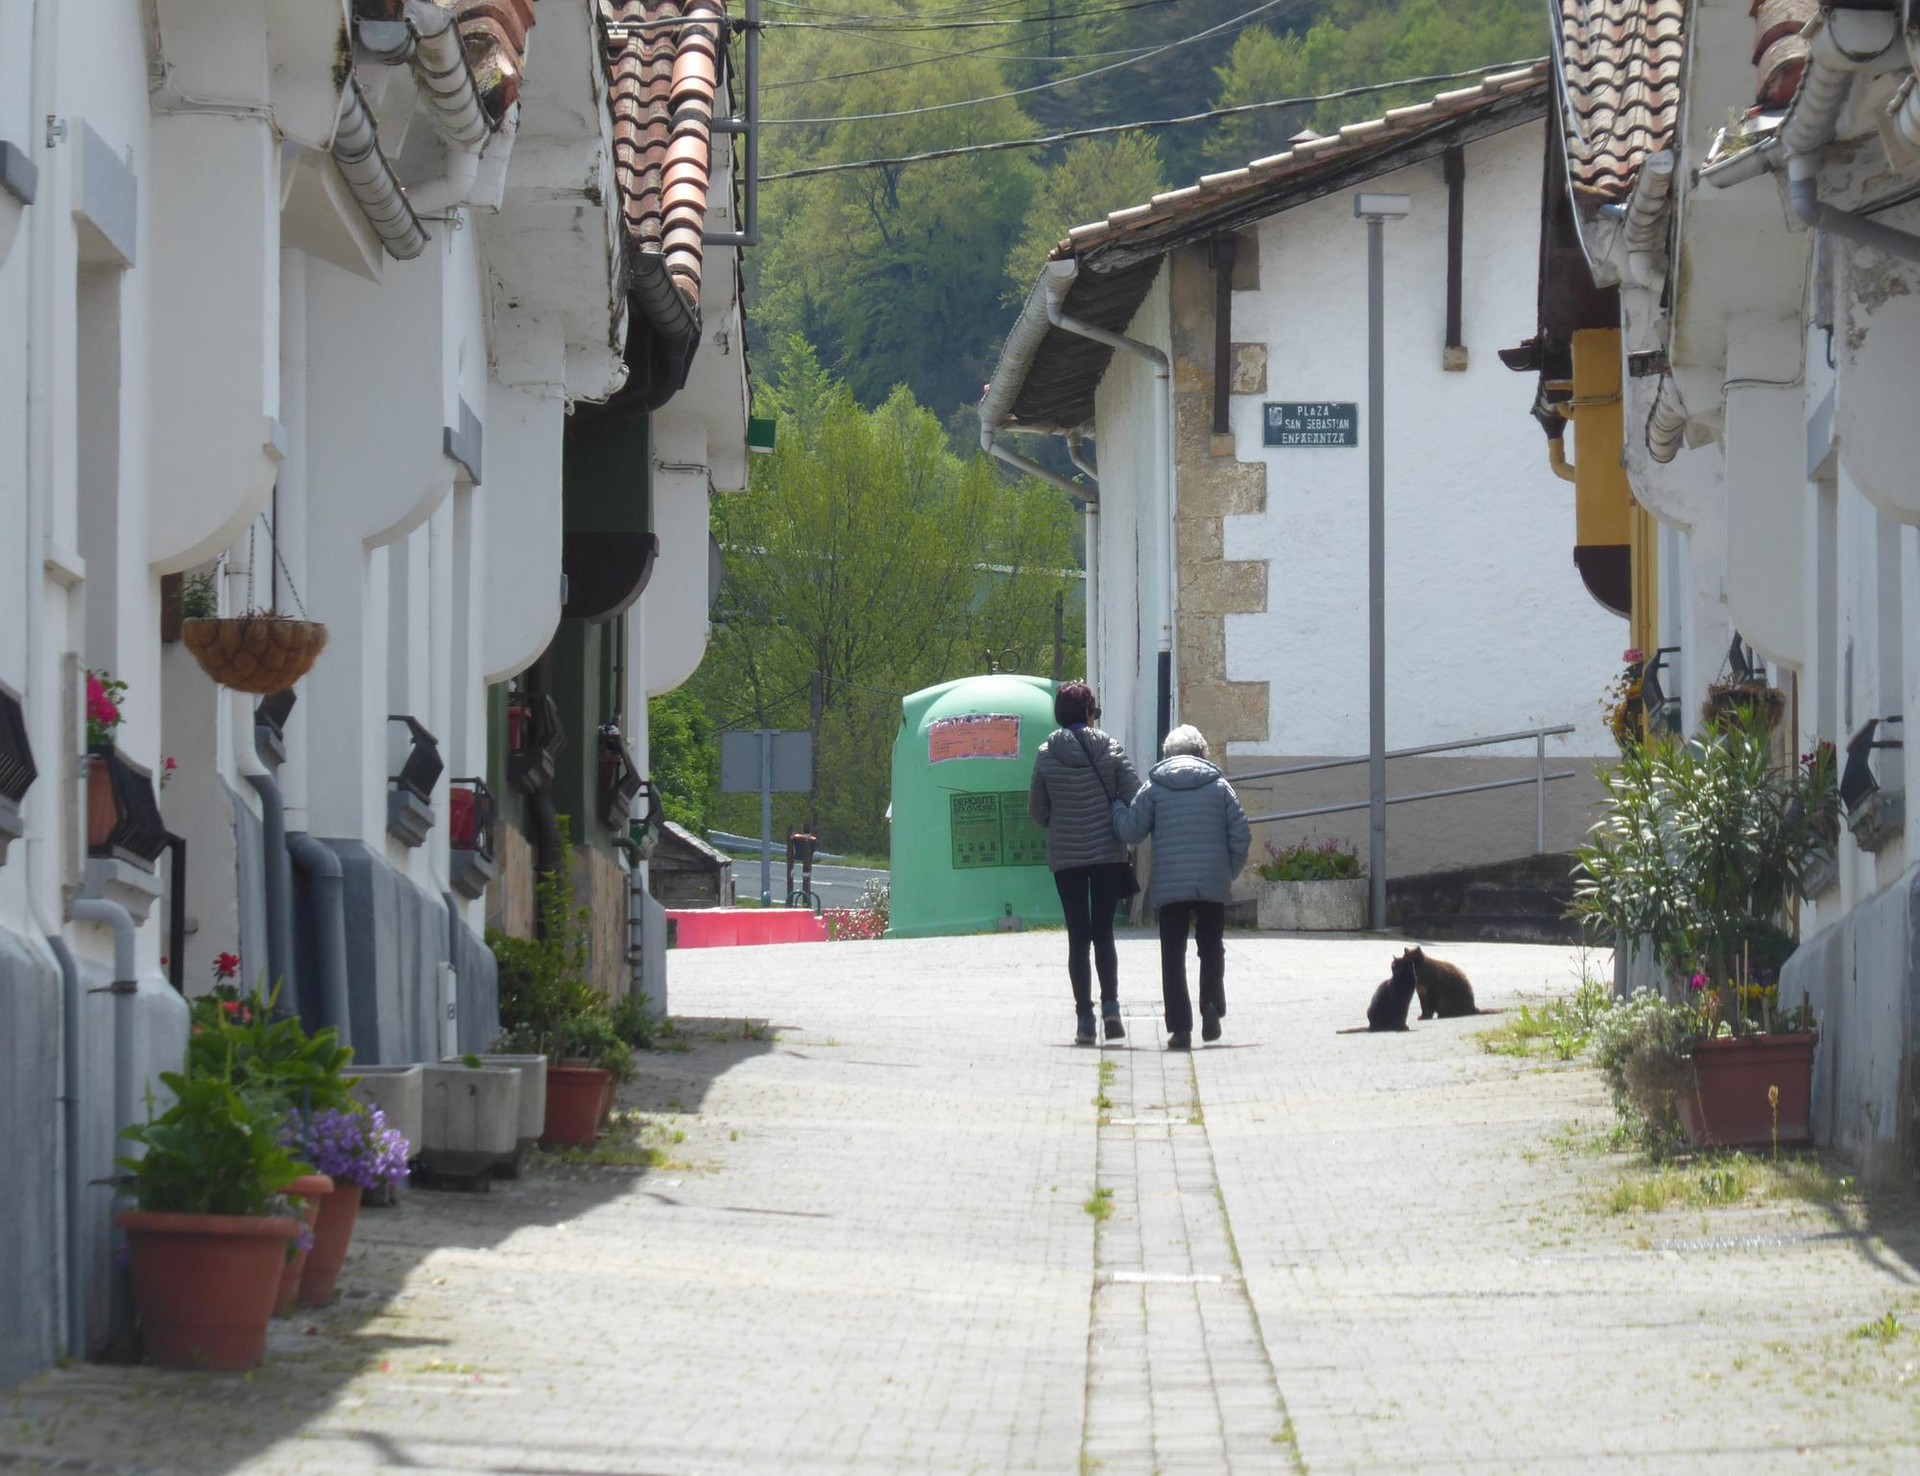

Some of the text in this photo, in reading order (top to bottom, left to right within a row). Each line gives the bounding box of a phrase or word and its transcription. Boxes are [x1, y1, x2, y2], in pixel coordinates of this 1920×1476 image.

[1297, 405, 1330, 417] PLAZA
[1284, 418, 1350, 430] SAN SEBASTIAN
[1281, 432, 1345, 444] ENPARANTZA
[953, 795, 996, 807] DEPOSITE
